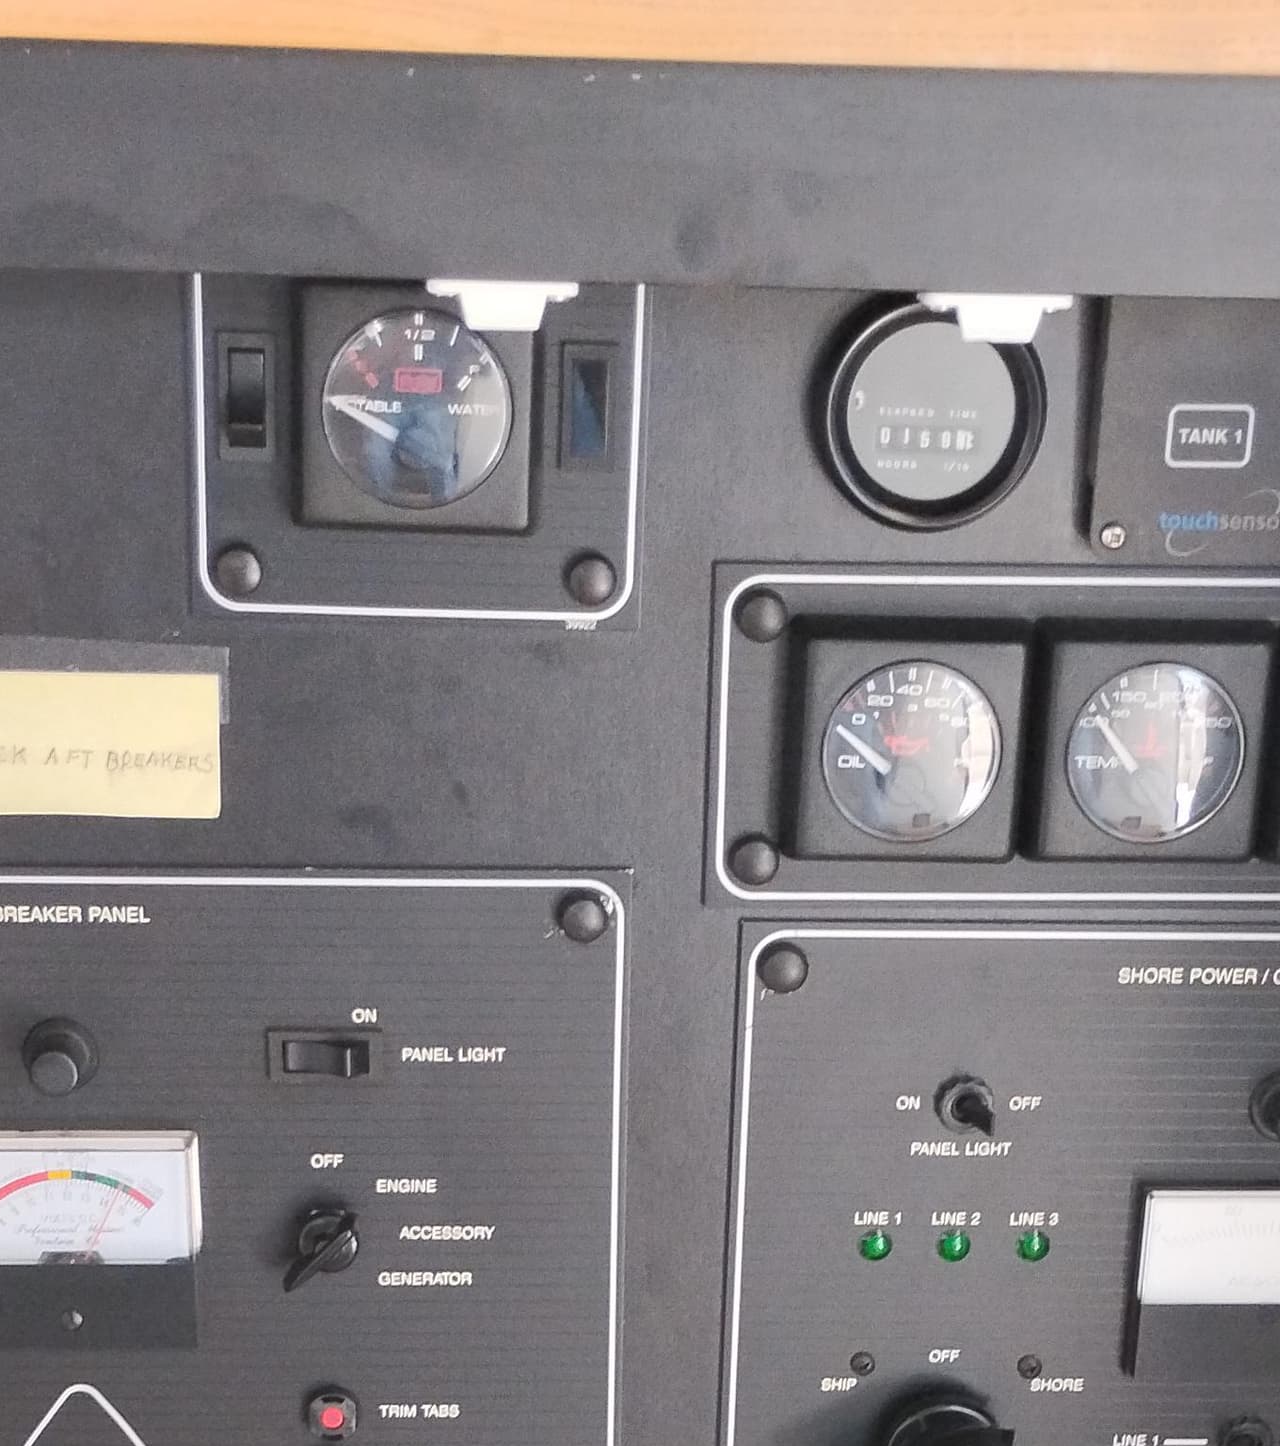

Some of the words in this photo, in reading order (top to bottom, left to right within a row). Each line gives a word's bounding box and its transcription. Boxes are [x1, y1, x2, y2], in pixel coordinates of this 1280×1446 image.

[1179, 428, 1225, 445] TANK
[896, 685, 923, 697] 40
[867, 695, 894, 707] 20
[43, 747, 94, 769] AFT
[105, 750, 214, 773] BREAKERS
[837, 755, 867, 770] OIL
[89, 906, 150, 923] PANEL
[1118, 967, 1183, 984] SHORE
[1190, 968, 1257, 984] POWER
[352, 1008, 377, 1023] ON
[402, 1048, 453, 1062] PANEL
[459, 1047, 506, 1062] LIGHT
[896, 1096, 920, 1110] ON
[1010, 1096, 1041, 1110] OFF
[911, 1142, 959, 1155] PANEL
[965, 1142, 1012, 1156] LIGHT
[311, 1154, 343, 1168] OFF
[376, 1179, 437, 1193] ENGINE
[854, 1212, 888, 1225] LINE
[932, 1212, 966, 1225] LINE
[1010, 1212, 1044, 1226] LINE
[400, 1226, 495, 1240] ACCESSORY
[378, 1272, 472, 1285] GENERATOR
[929, 1349, 960, 1362] OFF
[821, 1378, 857, 1391] SHIP
[1030, 1378, 1084, 1391] SHORE
[379, 1405, 416, 1417] TRIM
[421, 1404, 459, 1417] TABS
[1113, 1434, 1147, 1446] LINE
